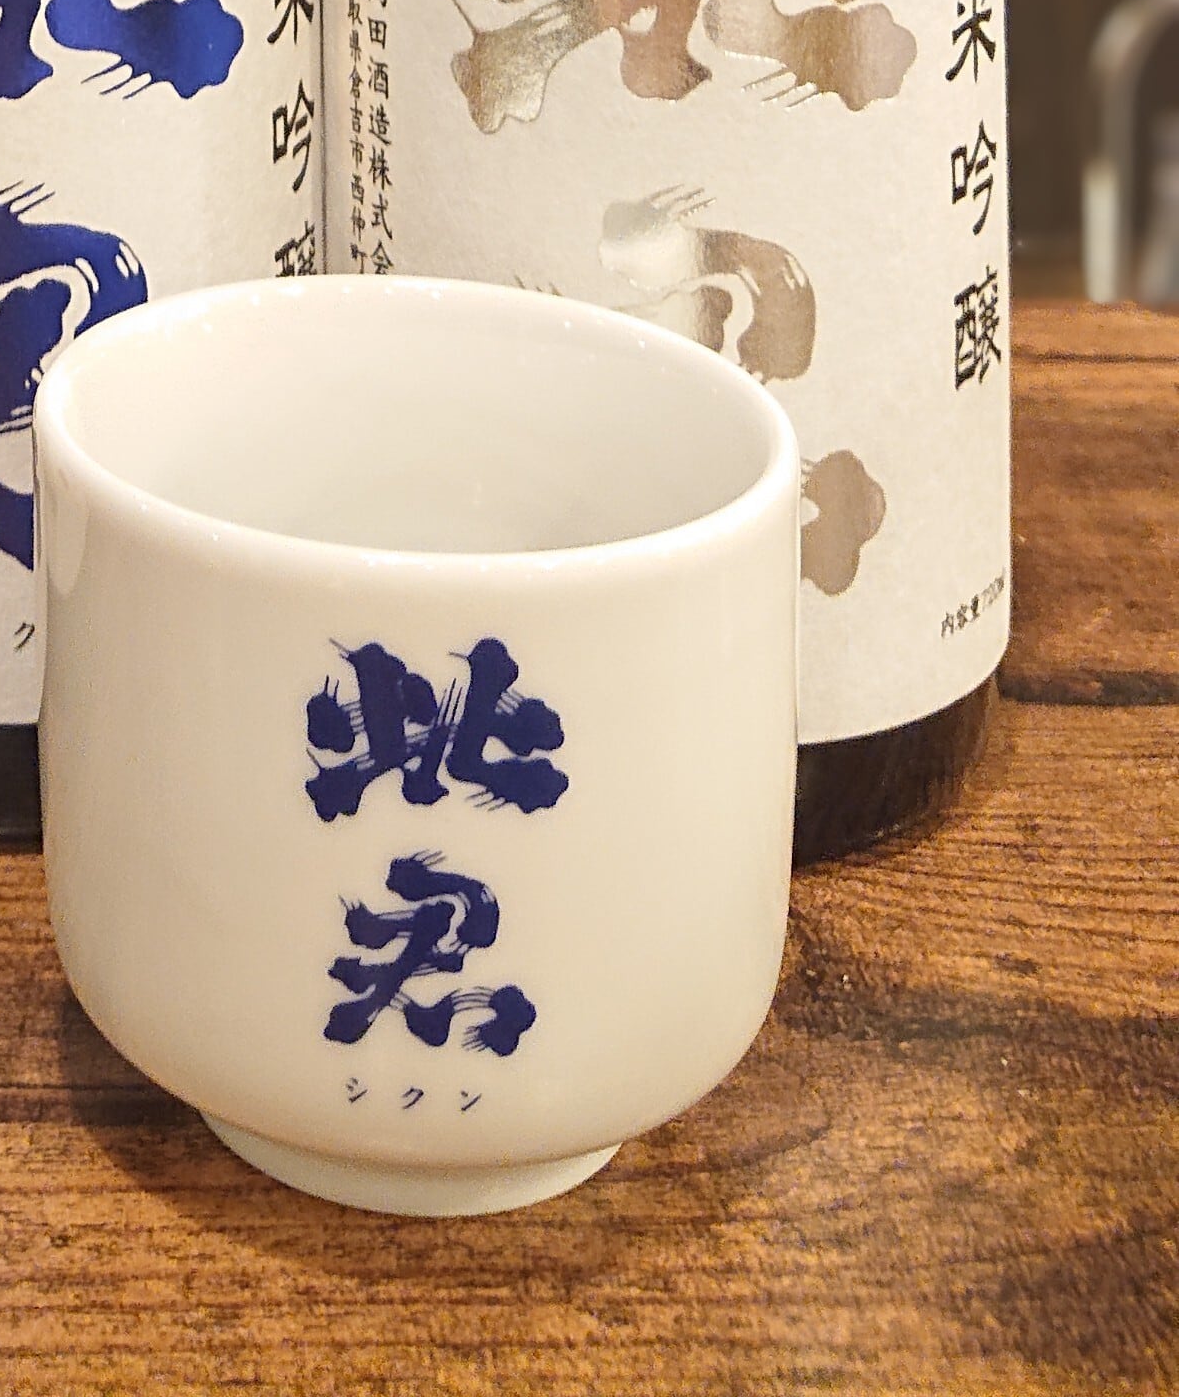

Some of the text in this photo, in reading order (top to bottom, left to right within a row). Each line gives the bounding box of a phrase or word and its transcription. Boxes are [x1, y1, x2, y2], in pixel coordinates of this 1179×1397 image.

[305, 637, 569, 1057] 此君
[345, 1077, 483, 1113] シクン
